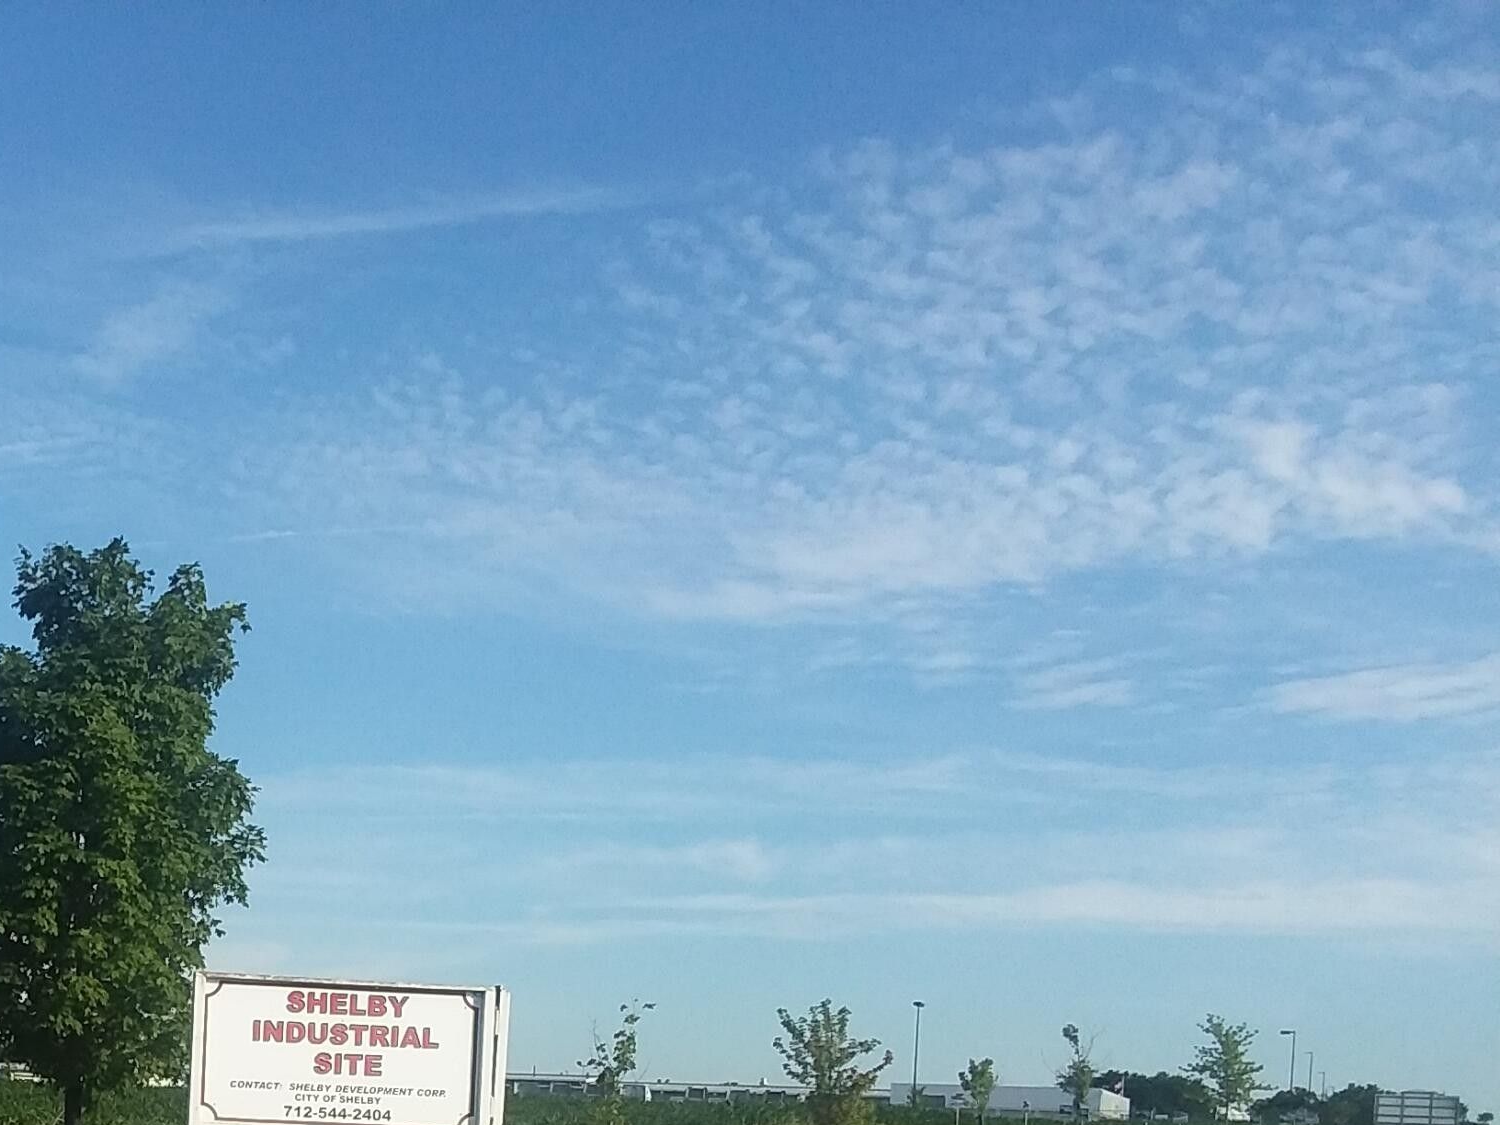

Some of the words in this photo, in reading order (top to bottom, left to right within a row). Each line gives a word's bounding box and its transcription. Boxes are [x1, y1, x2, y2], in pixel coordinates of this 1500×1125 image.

[286, 990, 409, 1018] SHELBY
[252, 1020, 440, 1049] INDUSTRIAL
[313, 1052, 383, 1076] SITE
[230, 1080, 282, 1090] CONTACT:
[289, 1082, 331, 1092] SHELBY
[335, 1085, 414, 1096] DEVELOPMENT
[417, 1088, 445, 1097] CORP.
[294, 1093, 319, 1103] CITY
[322, 1094, 337, 1104] OF
[339, 1095, 381, 1105] SHELBY
[283, 1105, 391, 1121] 712-544-2404
